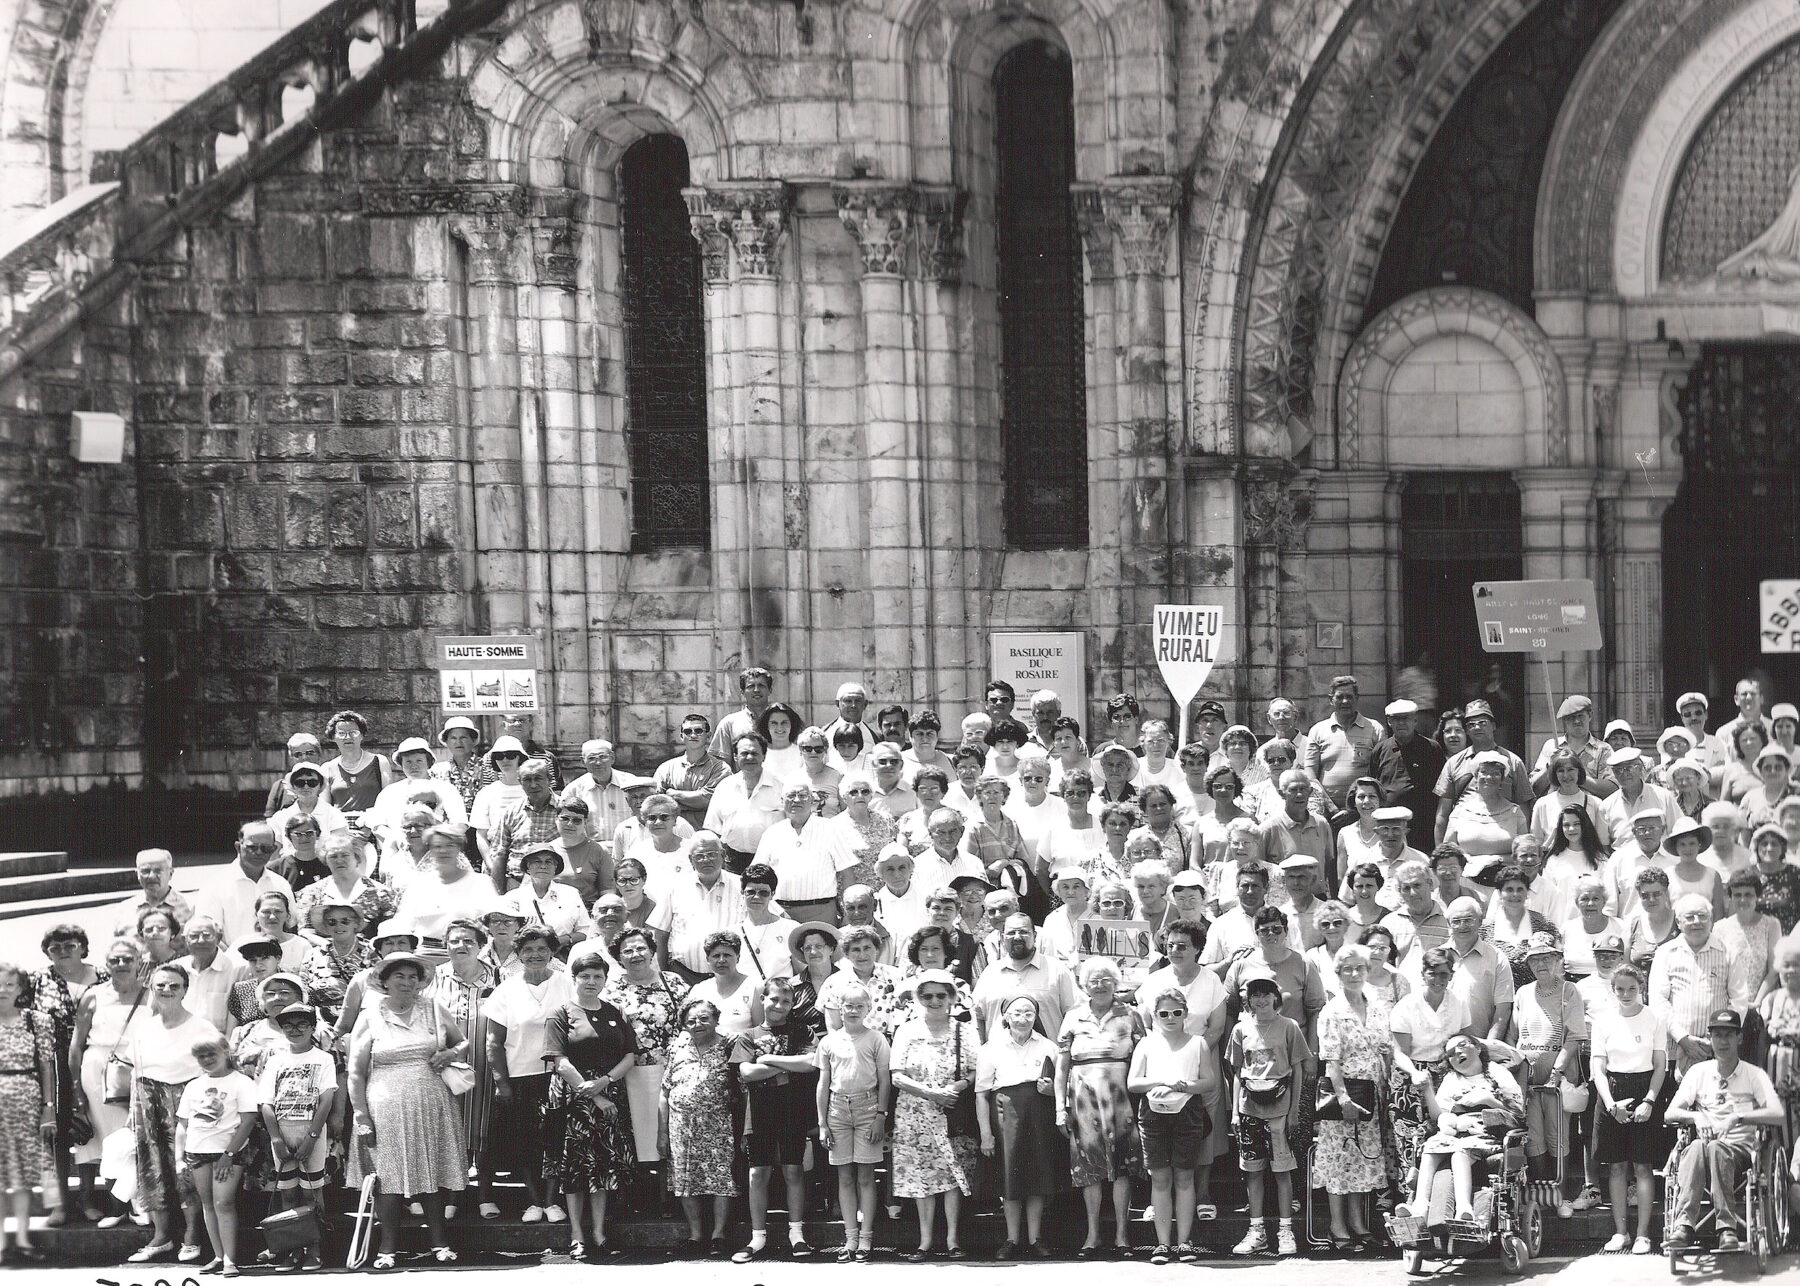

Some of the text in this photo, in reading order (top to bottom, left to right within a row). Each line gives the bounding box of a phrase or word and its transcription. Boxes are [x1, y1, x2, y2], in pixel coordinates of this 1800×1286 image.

[1158, 611, 1218, 636] VIMEU
[448, 646, 524, 657] HAUTE-SOMME
[1009, 648, 1063, 658] BASILIQUE
[1158, 638, 1213, 663] RURAL
[1029, 659, 1044, 668] DU
[1015, 670, 1059, 679] ROSAIRE
[509, 700, 535, 708] NESLE
[1520, 1043, 1551, 1052] allorca
